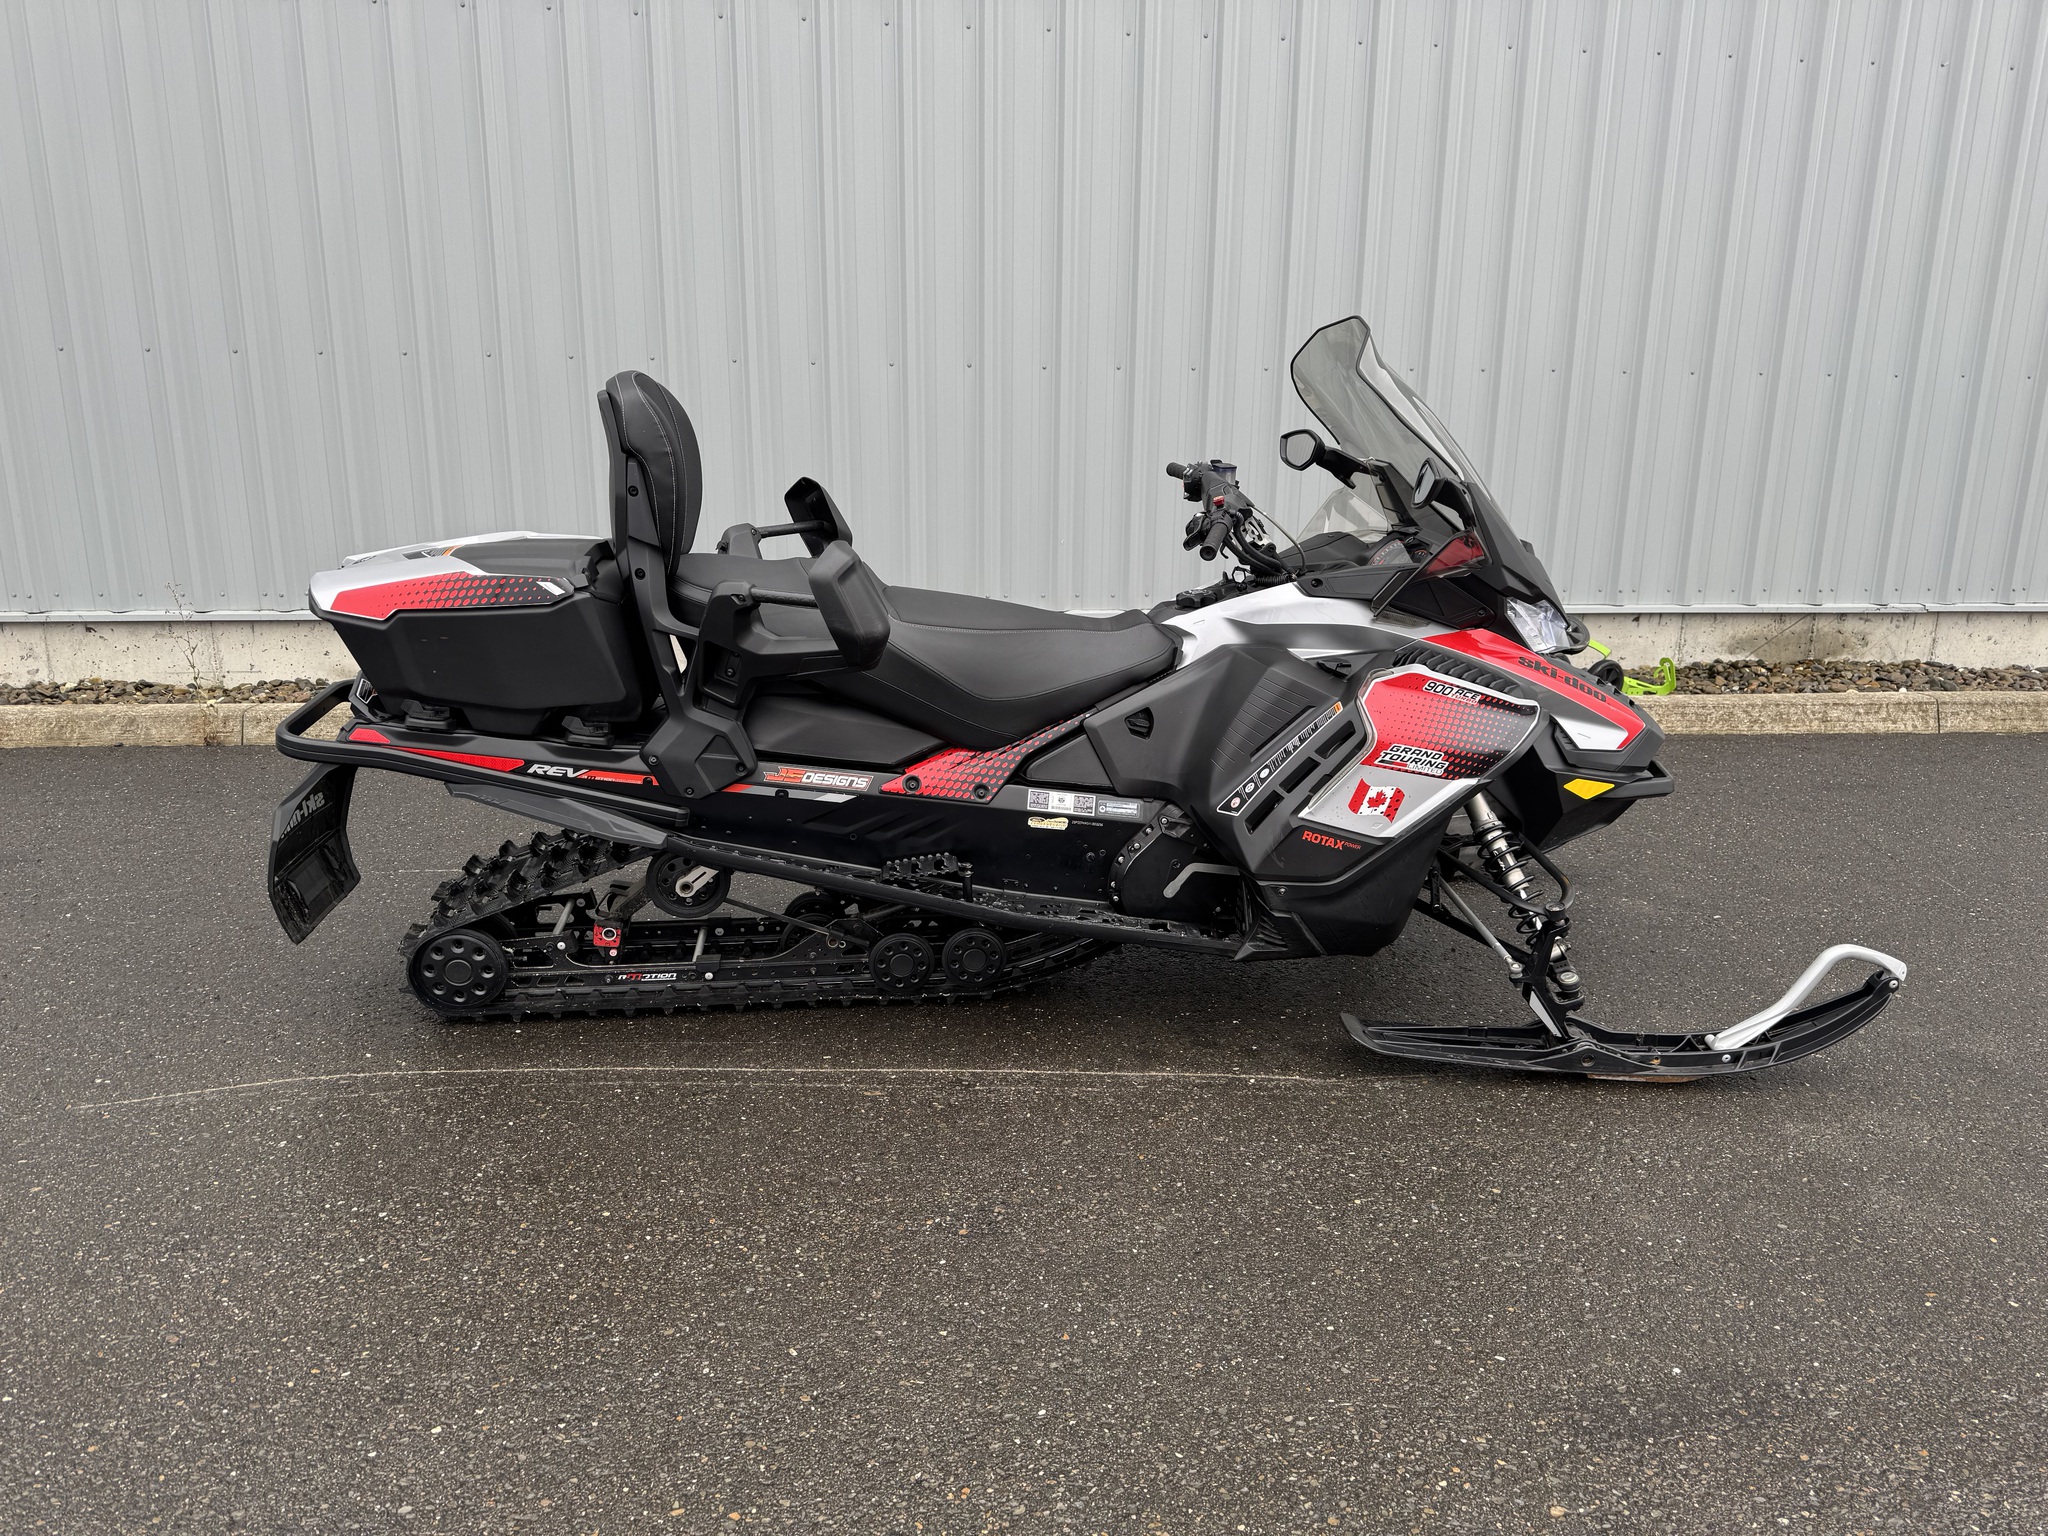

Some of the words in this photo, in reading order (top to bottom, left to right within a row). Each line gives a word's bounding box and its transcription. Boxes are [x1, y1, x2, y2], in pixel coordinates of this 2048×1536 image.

[1518, 656, 1607, 703] ski-doo
[1424, 681, 1453, 696] 900
[1454, 688, 1480, 701] ACE
[1381, 751, 1447, 770] TOURING
[1389, 744, 1443, 761] GRAND
[526, 763, 590, 778] REV
[1407, 763, 1443, 775] LIMITED
[1302, 830, 1345, 851] ROTAX
[1344, 841, 1362, 850] POWER
